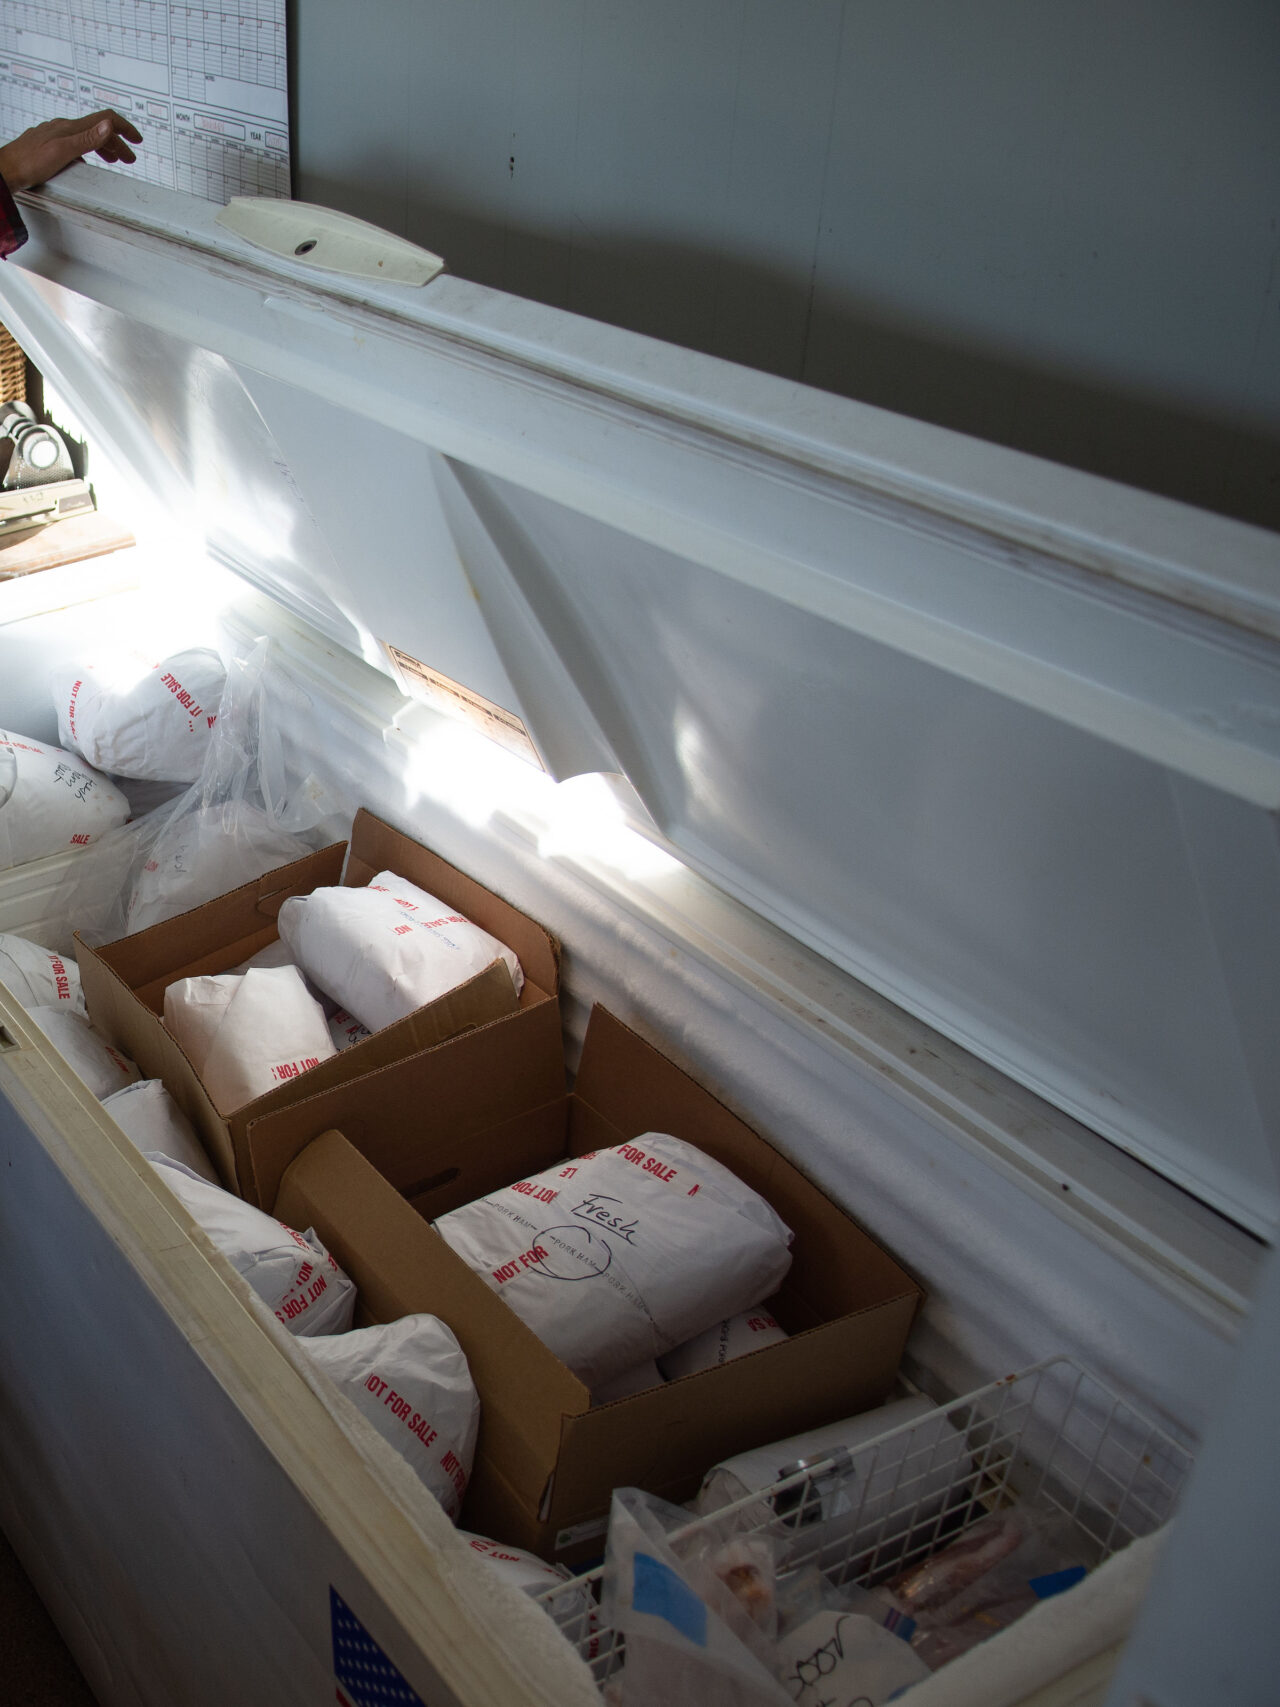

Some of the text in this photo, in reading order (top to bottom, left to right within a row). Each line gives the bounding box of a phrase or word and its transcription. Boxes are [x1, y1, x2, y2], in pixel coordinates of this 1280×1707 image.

[250, 131, 262, 142] YEAR
[72, 680, 83, 699] NOT
[160, 672, 182, 693] SALE
[176, 688, 196, 710] FOR
[69, 833, 92, 845] SALE
[52, 960, 66, 975] FOR
[56, 976, 71, 1000] SALE
[276, 1063, 300, 1080] FOR
[617, 1144, 646, 1165] FOR
[642, 1156, 678, 1183] SALE
[510, 1181, 537, 1196] FOR
[571, 1194, 639, 1245] Fresh
[492, 1245, 549, 1285] NOT FOR
[310, 1275, 327, 1303] NOT
[286, 1294, 309, 1319] FOR
[384, 1390, 412, 1422] FOR
[408, 1413, 438, 1448] SALE
[439, 1450, 460, 1477] NOT
[488, 1550, 520, 1562] NOT
